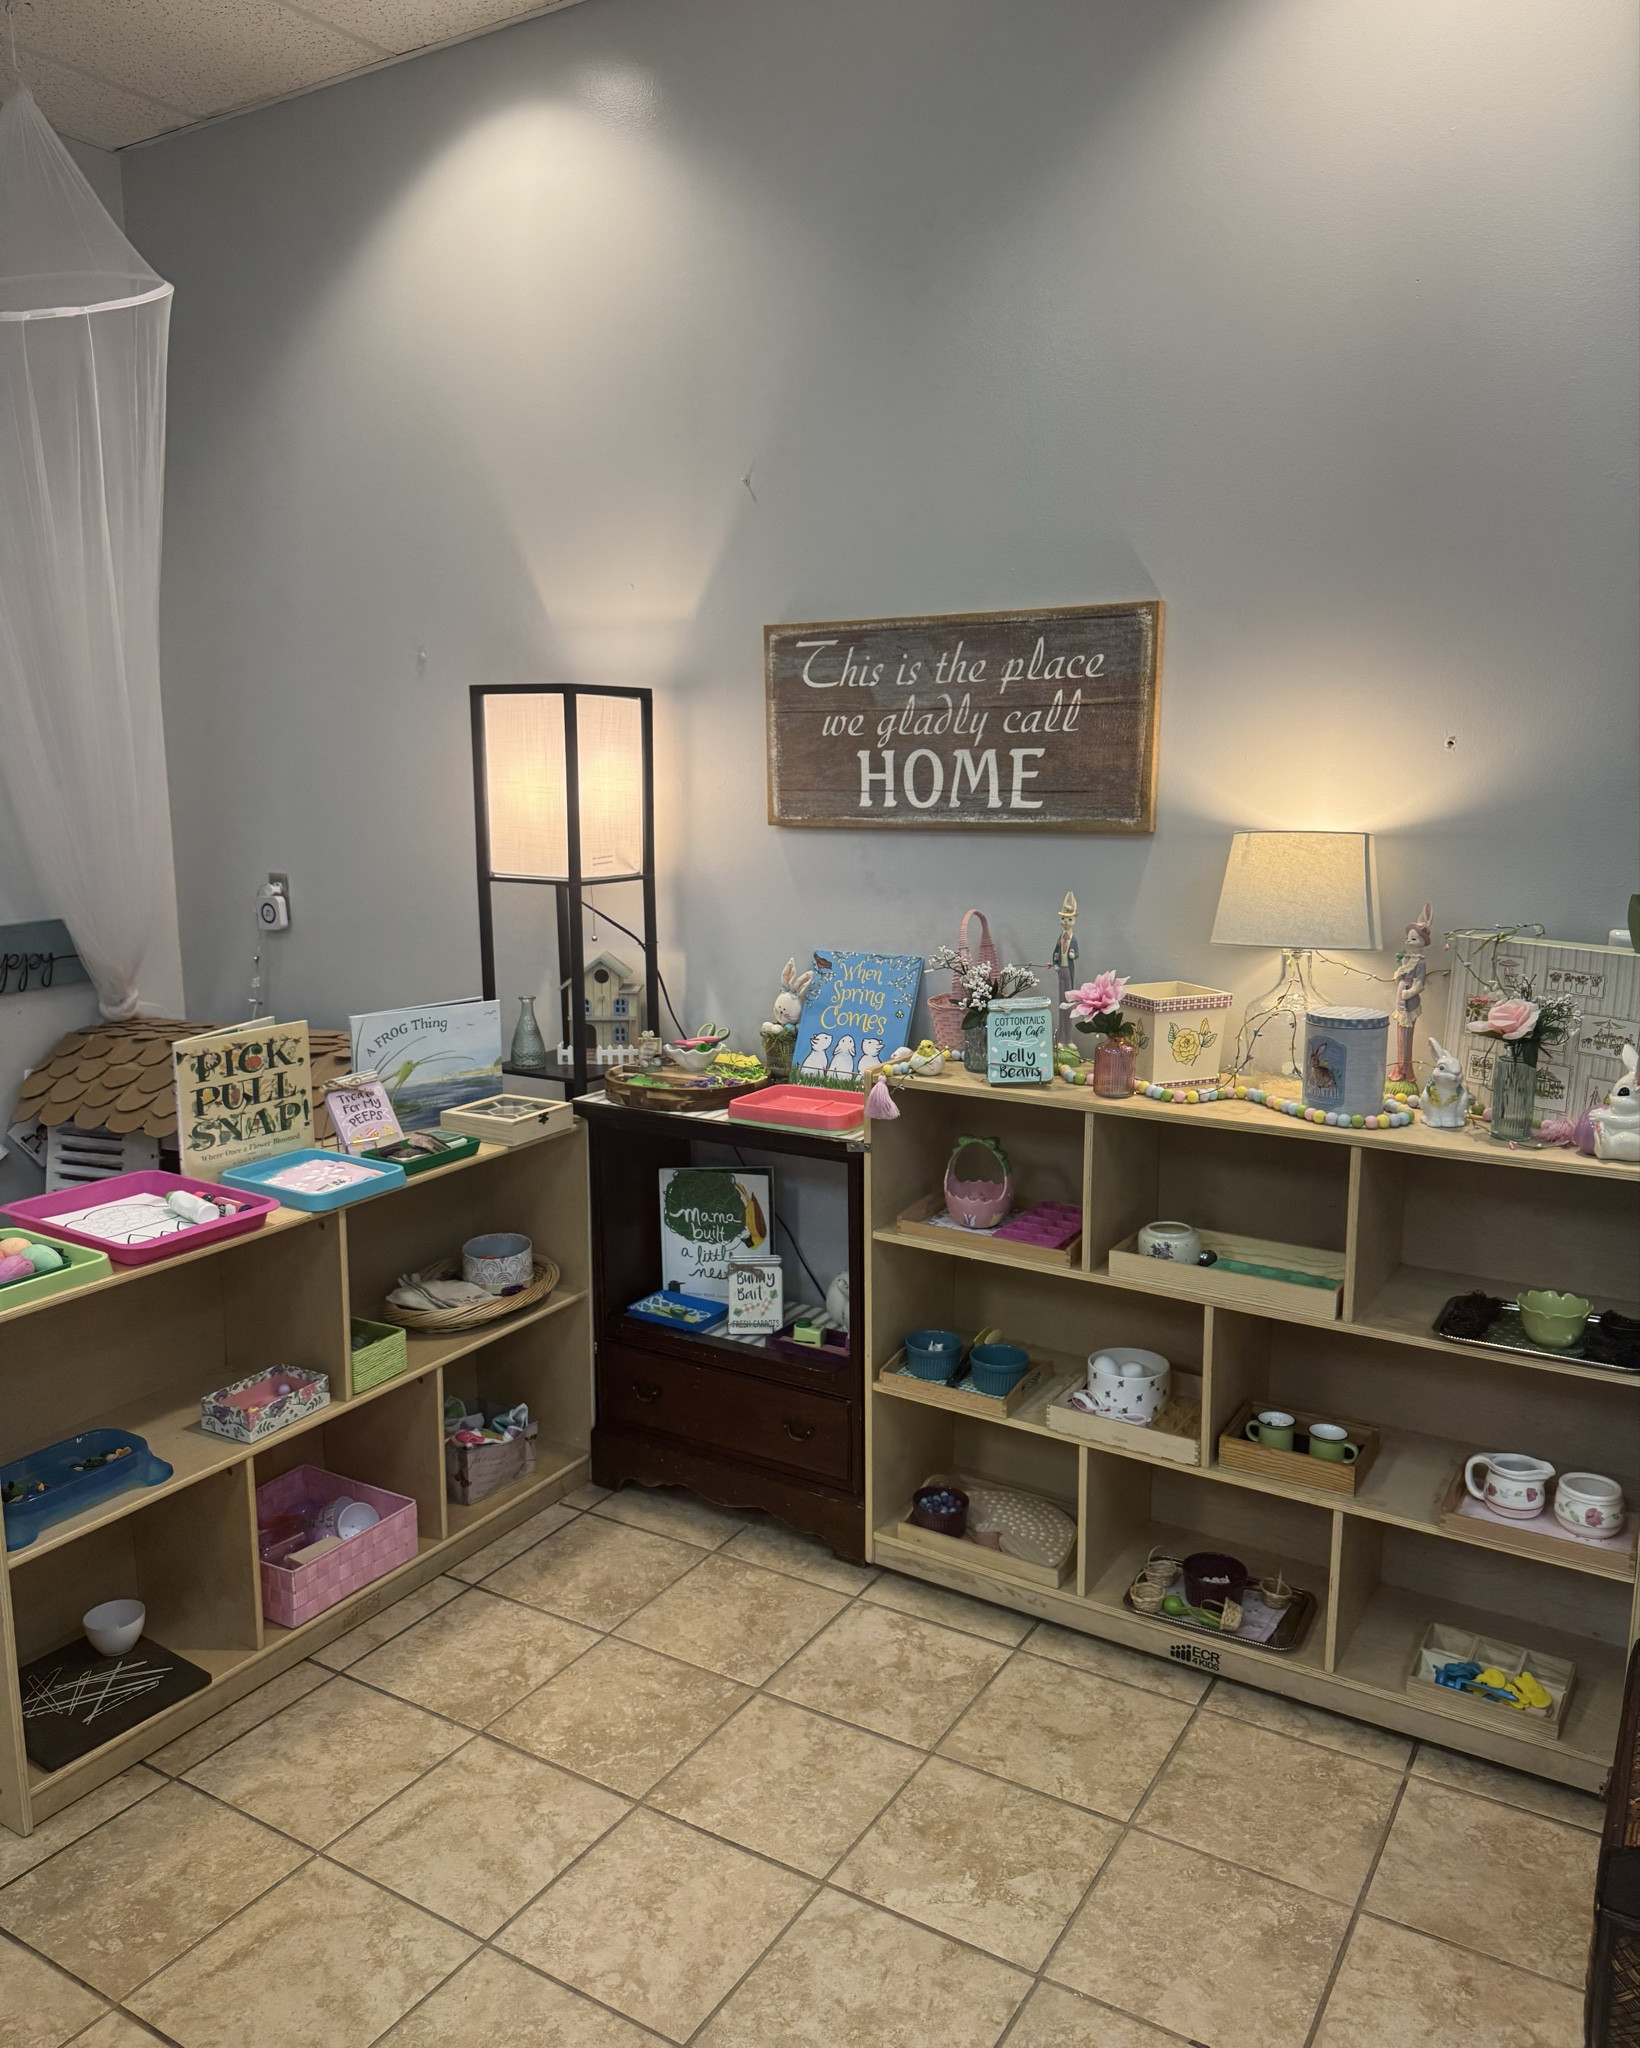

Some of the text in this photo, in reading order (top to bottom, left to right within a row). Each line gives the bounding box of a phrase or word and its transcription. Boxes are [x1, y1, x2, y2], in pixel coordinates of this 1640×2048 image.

[796, 636, 1105, 694] This is the place
[821, 688, 1082, 748] we gladly call
[856, 747, 1046, 809] HOME
[840, 960, 882, 985] When
[831, 980, 885, 1010] Spring
[821, 1005, 887, 1035] Comes
[994, 1015, 1046, 1027] COTTONTAIL'S
[366, 1016, 448, 1058] A FROG Thing
[994, 1026, 1022, 1040] Candy
[192, 1036, 305, 1083] PICK,
[1001, 1048, 1036, 1066] Jelly
[1000, 1065, 1041, 1078] Beans
[190, 1070, 307, 1118] PULL,
[336, 1089, 374, 1104] Trea
[343, 1098, 381, 1115] For My
[188, 1098, 310, 1152] SNAP!
[349, 1110, 383, 1128] PEEPS
[201, 1152, 224, 1162] Where
[691, 1222, 725, 1240] built
[681, 1247, 693, 1258] a
[688, 1266, 728, 1280] nes
[737, 1285, 763, 1301] Bait
[1192, 1646, 1220, 1664] ECR
